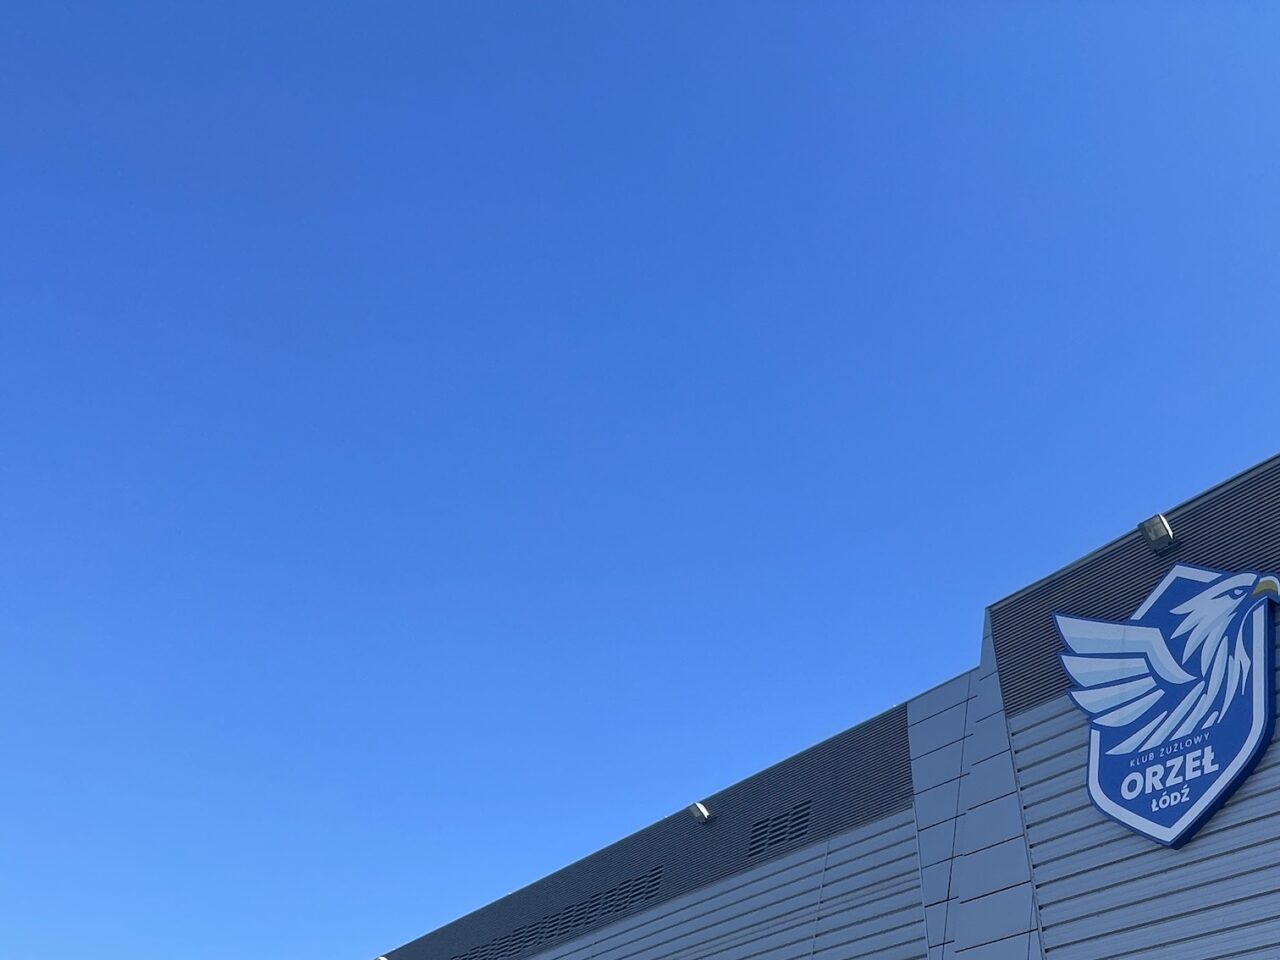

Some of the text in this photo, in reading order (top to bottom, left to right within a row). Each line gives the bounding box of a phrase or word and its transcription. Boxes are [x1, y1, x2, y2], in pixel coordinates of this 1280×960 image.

[1120, 745, 1220, 800] ORZEŁ
[1130, 752, 1155, 767] KLUB
[1151, 784, 1190, 812] ŁÓDŹ
